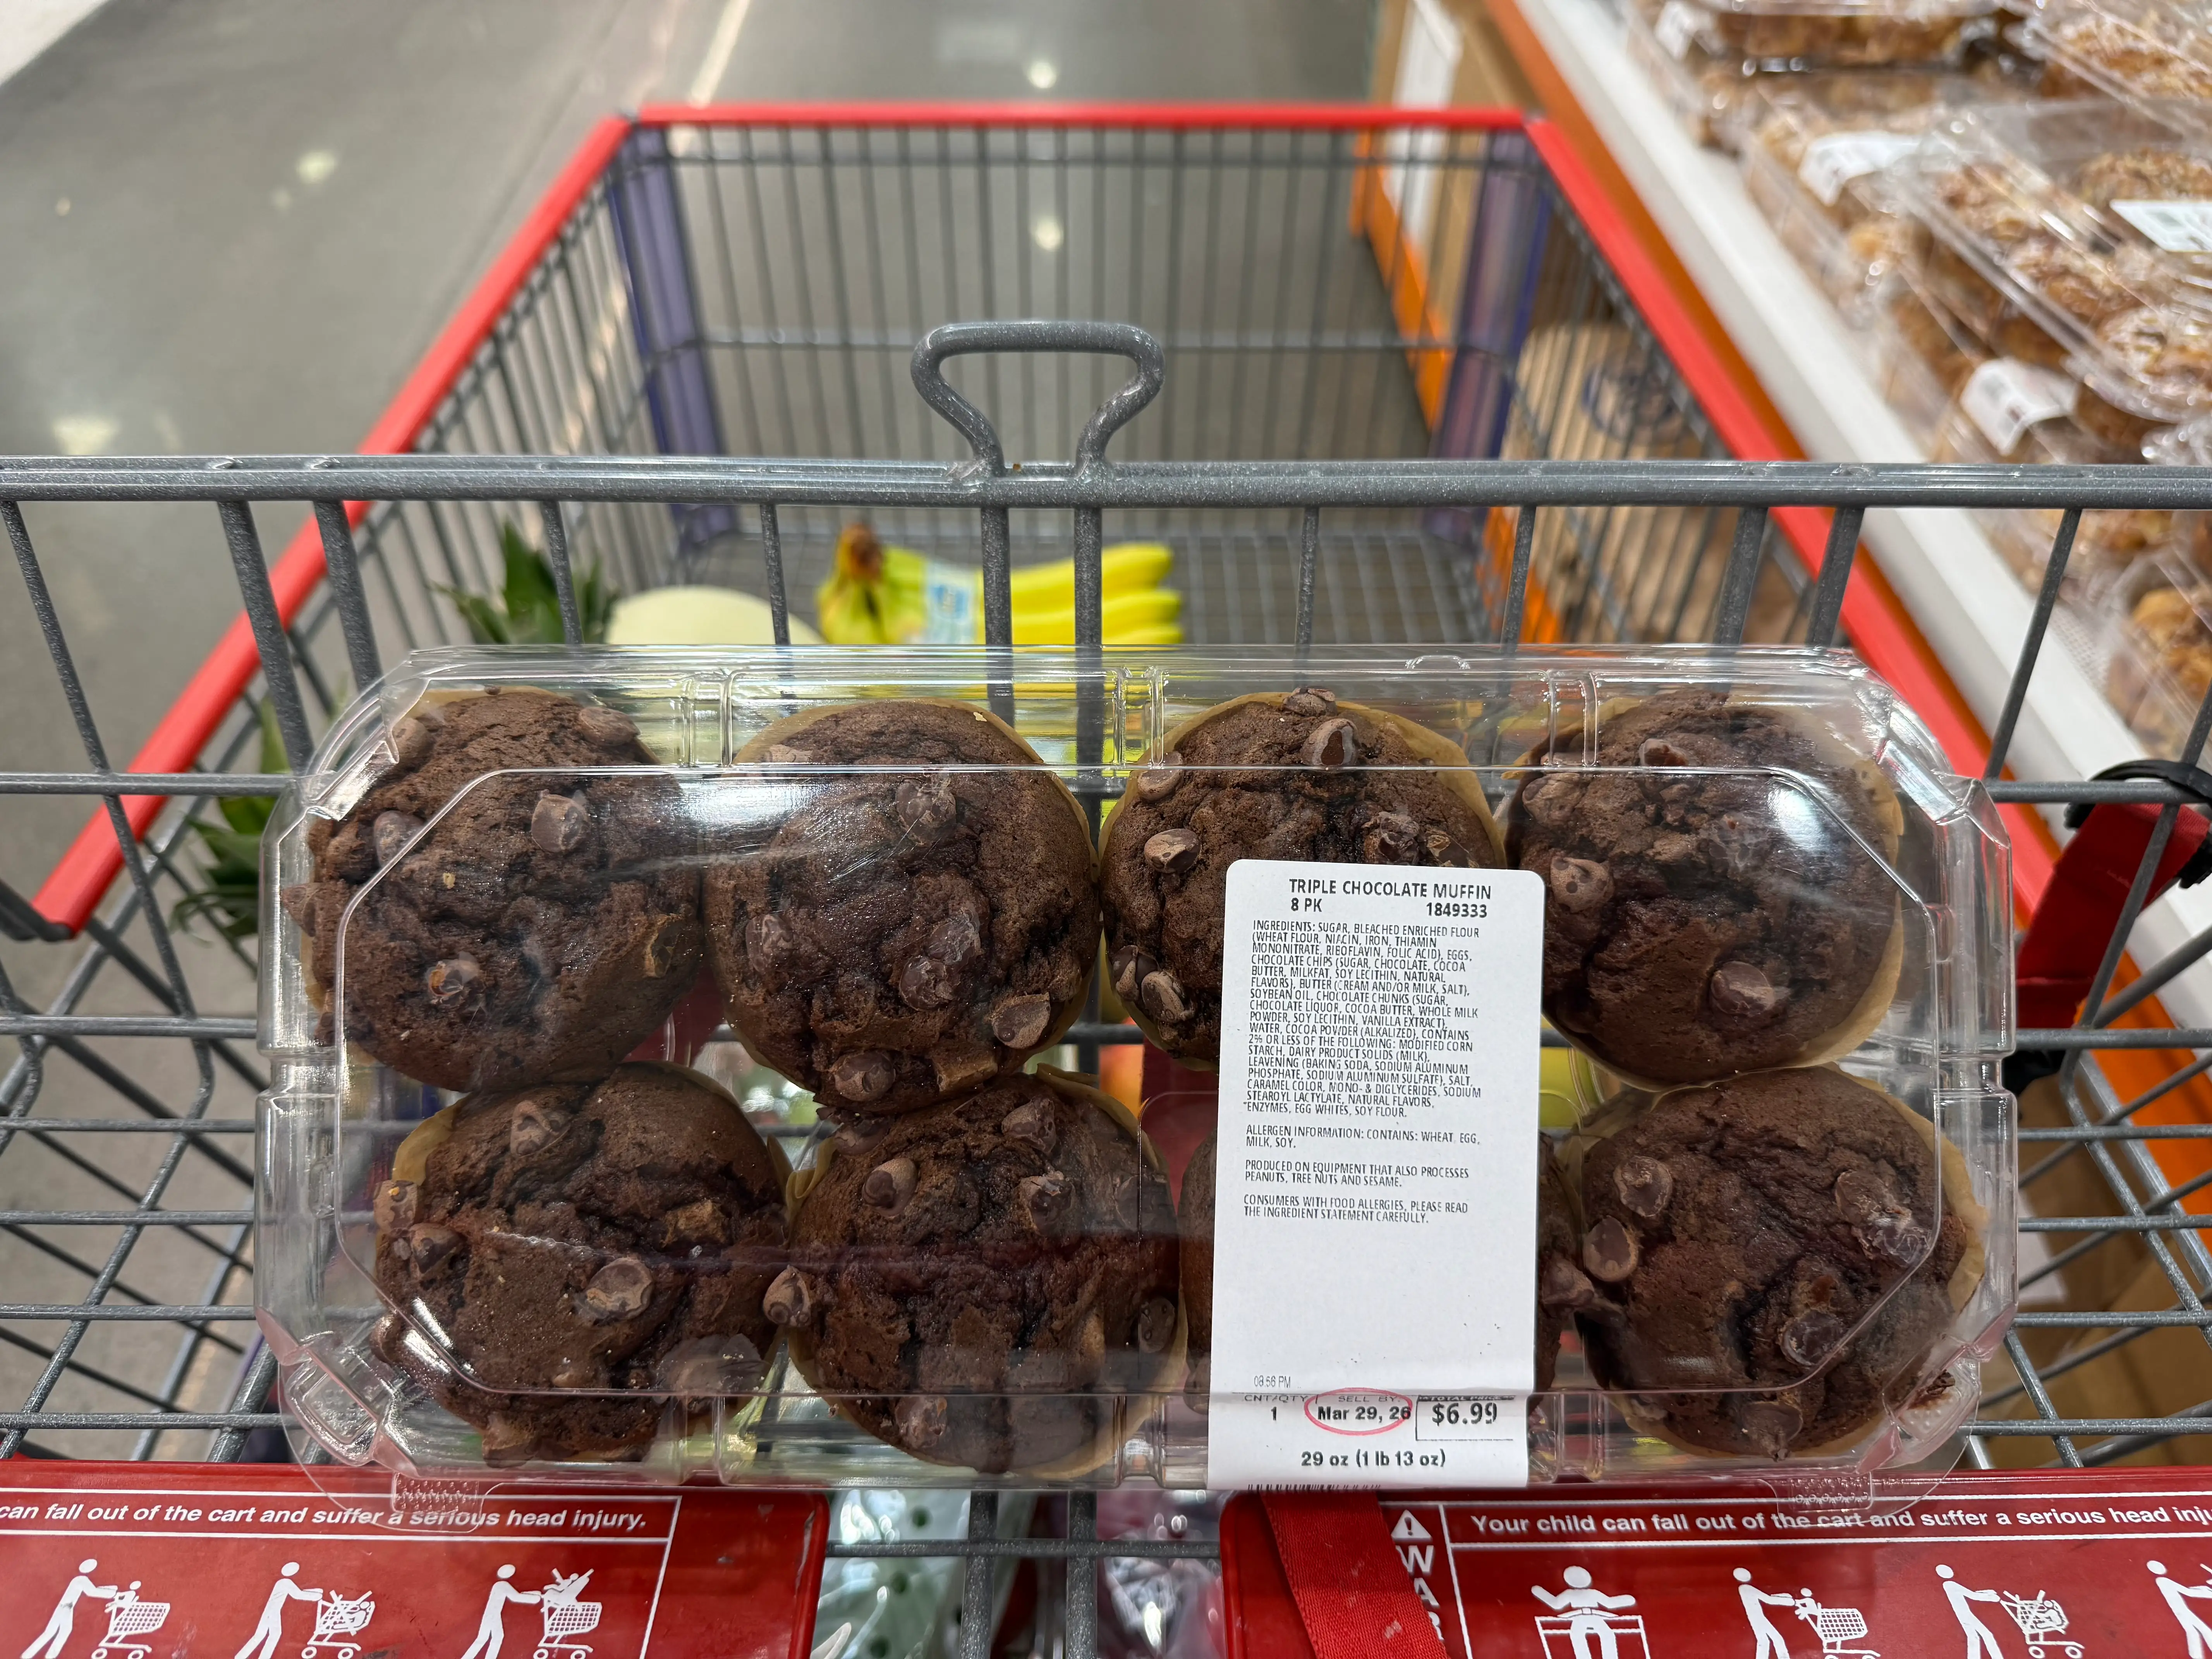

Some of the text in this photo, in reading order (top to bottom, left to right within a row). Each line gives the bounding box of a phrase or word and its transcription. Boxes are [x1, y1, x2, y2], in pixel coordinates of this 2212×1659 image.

[1289, 878, 1491, 900] TRIPLE CHOCOLATE MUFFIN
[1290, 897, 1322, 912] 8 PK
[1426, 902, 1487, 918] 1849333
[1253, 920, 1479, 938] INGREDIENTS: SUGAR, BLEACHED ENRICHED FLOUR
[1252, 932, 1437, 948] (WHEAT FLOUR, NIACIN, IRON, THIAMIN
[1252, 943, 1472, 962] MONONITRATE, RIBOFLAVIN, FOLIC ACID), EGGS,
[1251, 954, 1466, 972] CHOCOLATE CHIPS (SUGAR, CHOCOLATE, COCOA
[1251, 966, 1446, 982] BUTTER, MILKFAT, SOY LECITHIN, NATURAL
[1251, 977, 1470, 997] FLAVORS), BUTTER (CREAM AND/OR MILK, SALT),
[1250, 988, 1448, 1007] SOYBEAN OIL, CHOCOLATE CHUNKS (SUGAR,
[1250, 1000, 1479, 1018] CHOCOLATE LIQUOR, COCOA BUTTER, WHOLE MILK
[1250, 1012, 1448, 1030] POWDER, SOY LECITHIN, VANILLA EXTRACT),
[1249, 1022, 1469, 1041] WATER, COCOA POWDER (ALKALIZED), CONTAINS
[1249, 1034, 1473, 1051] 2% OR LESS OF THE FOLLOWING: MODIFIED CORN
[1248, 1045, 1430, 1064] STARCH, DAIRY PRODUCT SOLIDS (MILK),
[1249, 1056, 1468, 1074] LEAVENING (BAKING SODA, SODIUM ALUMINUM
[1247, 1102, 1407, 1118] ENZYMES, EGG WHITES, SOY FLOUR.
[1246, 1125, 1291, 1136] ALLERGEN
[1294, 1126, 1364, 1139] INFORMATION:
[1367, 1129, 1418, 1140] CONTAINS:
[1460, 1132, 1480, 1144] EGG,
[1246, 1136, 1296, 1148] MILK, SOY.
[1245, 1159, 1469, 1178] PRODUCED ON EQUIPMENT THAT ALSO PROCESSES
[1245, 1171, 1402, 1187] PEANUTS, TREE NUTS AND SESAME.
[1244, 1194, 1468, 1212] CONSUMERS WITH FOOD ALLERGIES, PLEASE READ
[1244, 1206, 1429, 1223] THE INGREDIENT STATEMENT CAREFULLY.
[1279, 1376, 1290, 1388] PM
[1271, 1406, 1277, 1421] 1
[1317, 1406, 1412, 1423] Mar 29, 26
[1432, 1402, 1498, 1426] $6.99
[1301, 1448, 1446, 1467] 29 oz (1 lb 13 oz)
[0, 1503, 646, 1531] can fall out of the cart and suffer a serious head injury.
[1471, 1515, 1530, 1533] Your
[1537, 1513, 1597, 1532] child
[1602, 1516, 1646, 1532] can
[1651, 1513, 1689, 1531] fall
[1695, 1515, 1740, 1531] out
[1742, 1513, 1765, 1530] of
[1771, 1512, 1813, 1528] the
[1817, 1513, 1865, 1527] cart
[1869, 1511, 1915, 1526] and
[1920, 1510, 1988, 1525] suffer
[1996, 1513, 2012, 1525] a
[2018, 1508, 2106, 1525] serious
[2108, 1507, 2172, 1523] head
